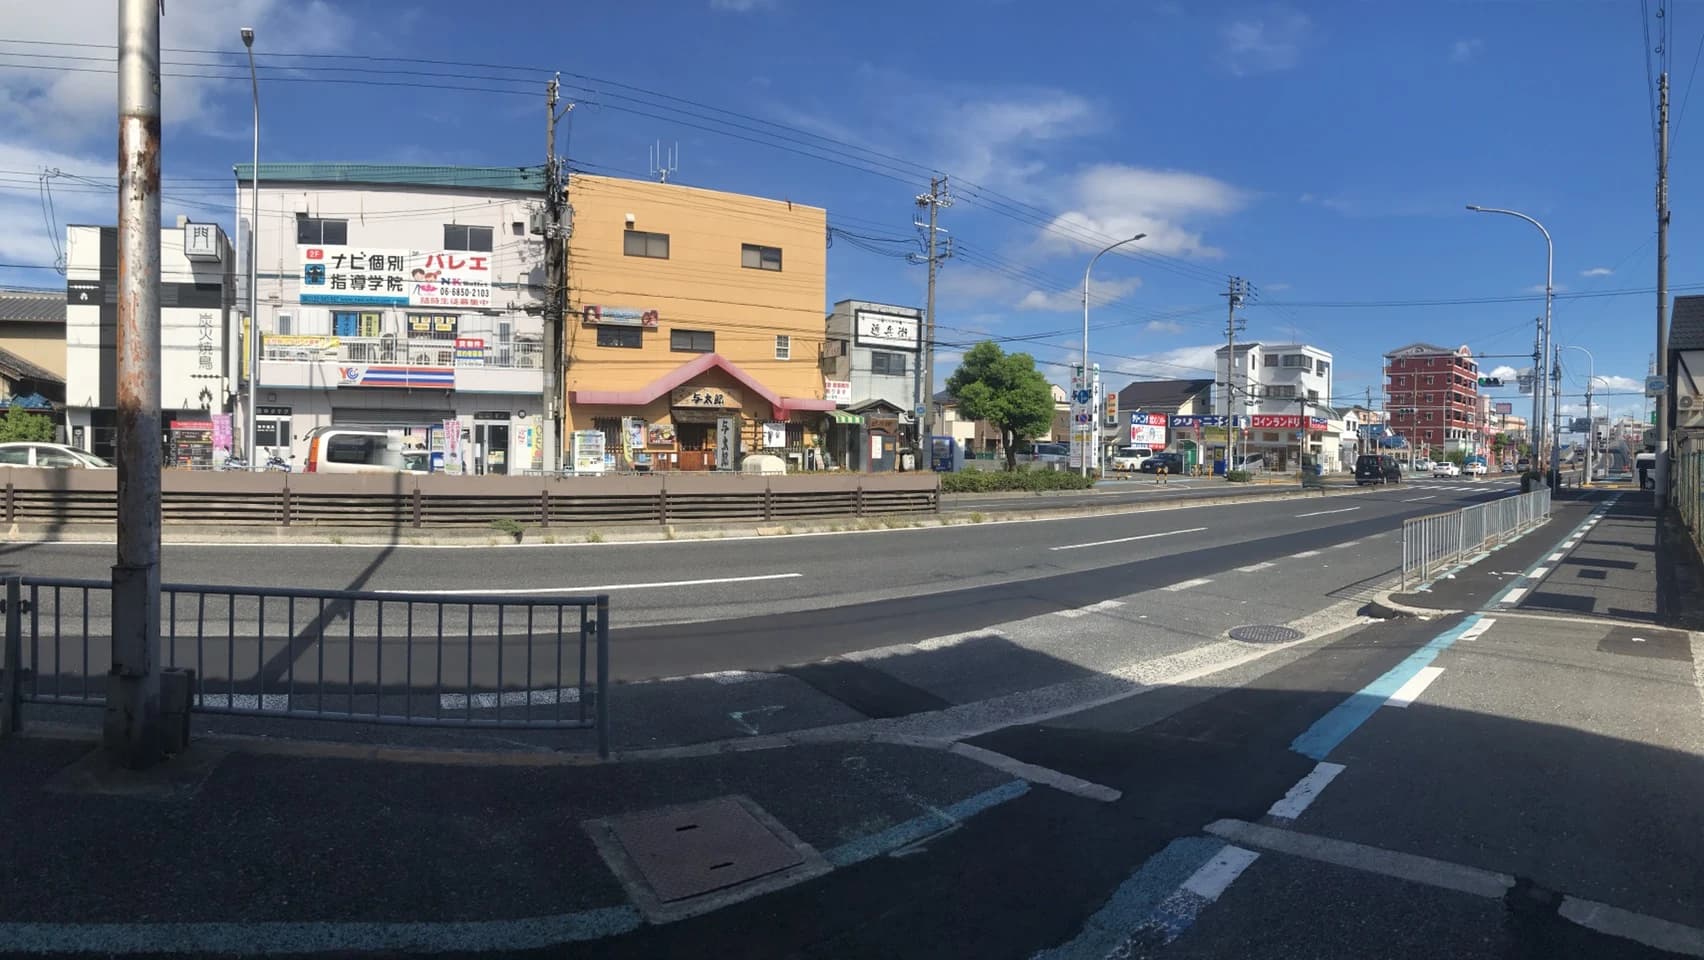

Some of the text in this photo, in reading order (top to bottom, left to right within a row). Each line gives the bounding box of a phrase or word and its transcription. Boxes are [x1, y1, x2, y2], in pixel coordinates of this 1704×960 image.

[309, 250, 320, 258] 2F
[331, 251, 404, 272] ナビ個別
[425, 253, 488, 271] バレエ
[330, 273, 404, 292] 指導学院
[440, 287, 490, 298] 06-6850-2103
[198, 312, 214, 370] 炭火焼鳥
[1253, 415, 1307, 427] コインランドリ
